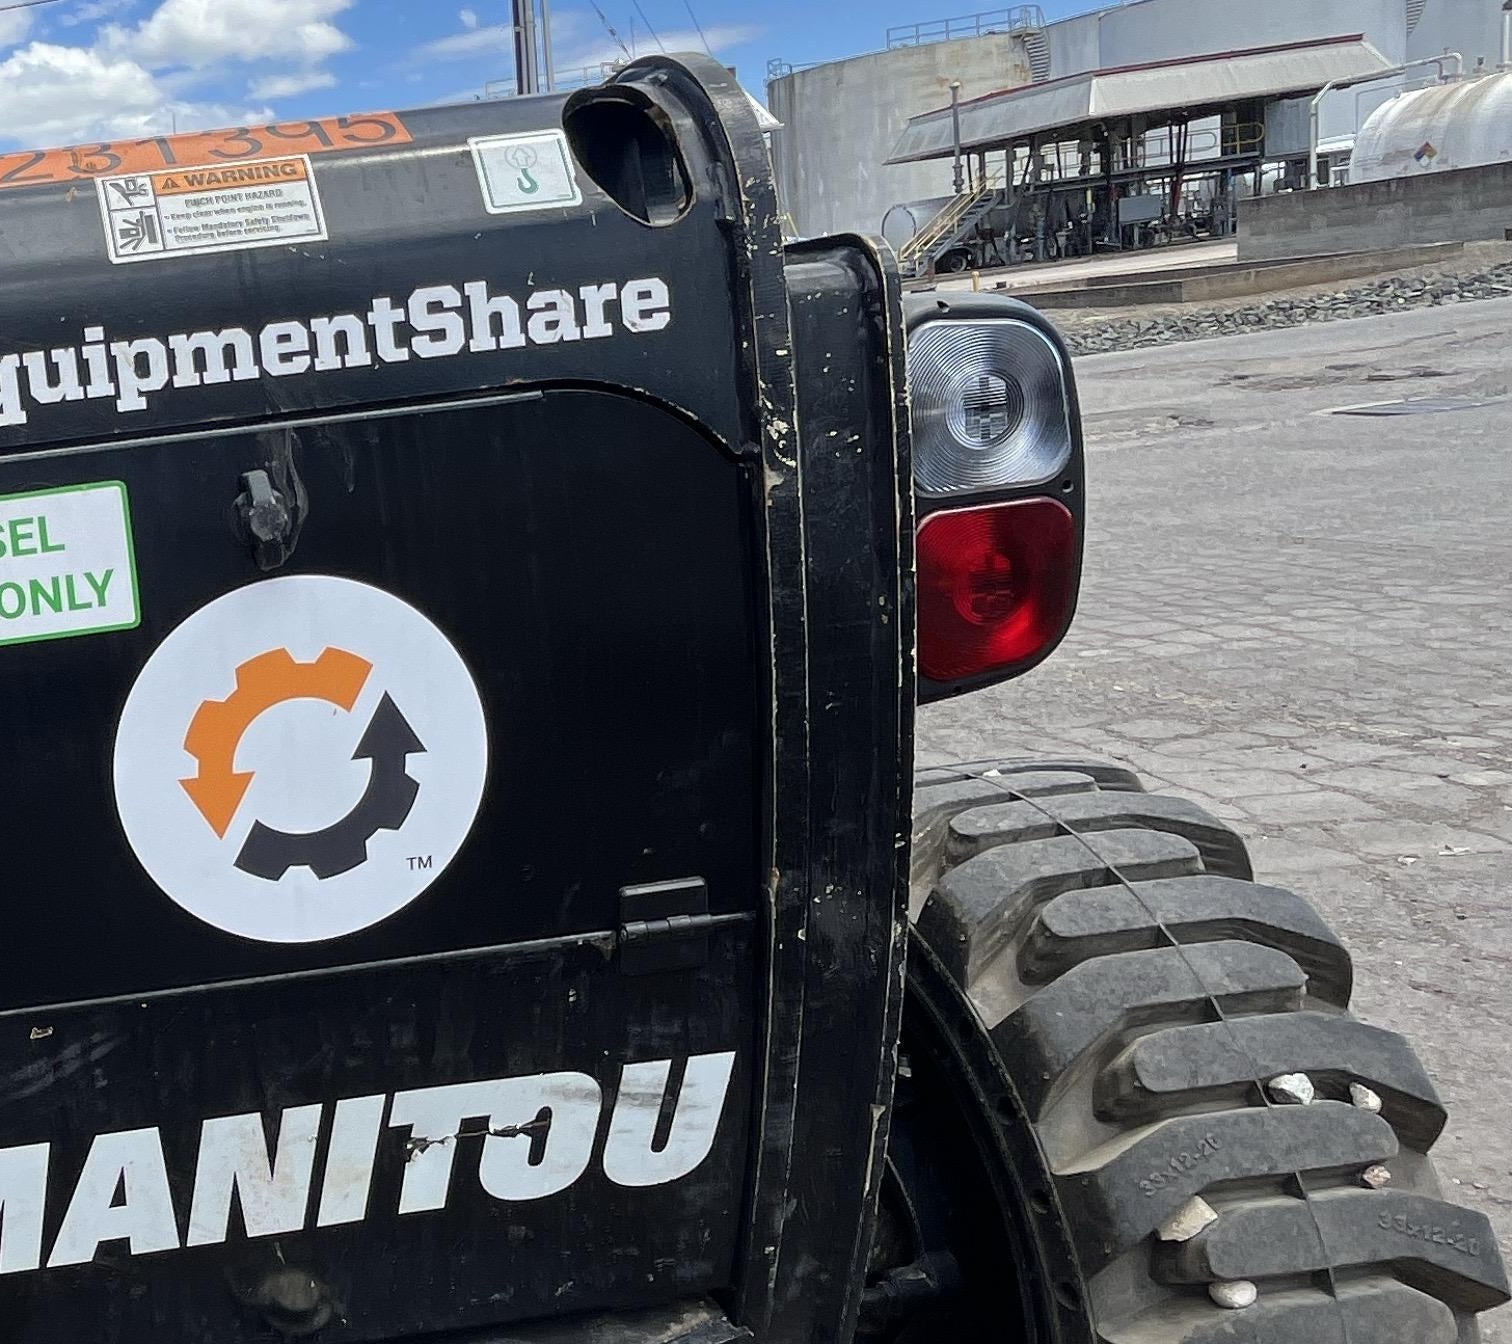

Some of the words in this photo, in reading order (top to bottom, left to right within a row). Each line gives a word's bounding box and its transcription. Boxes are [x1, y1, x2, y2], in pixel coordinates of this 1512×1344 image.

[183, 162, 298, 187] WARNING
[183, 195, 214, 208] PINCH
[214, 192, 244, 204] POINT
[243, 188, 284, 201] HAZARD
[405, 855, 433, 871] TM
